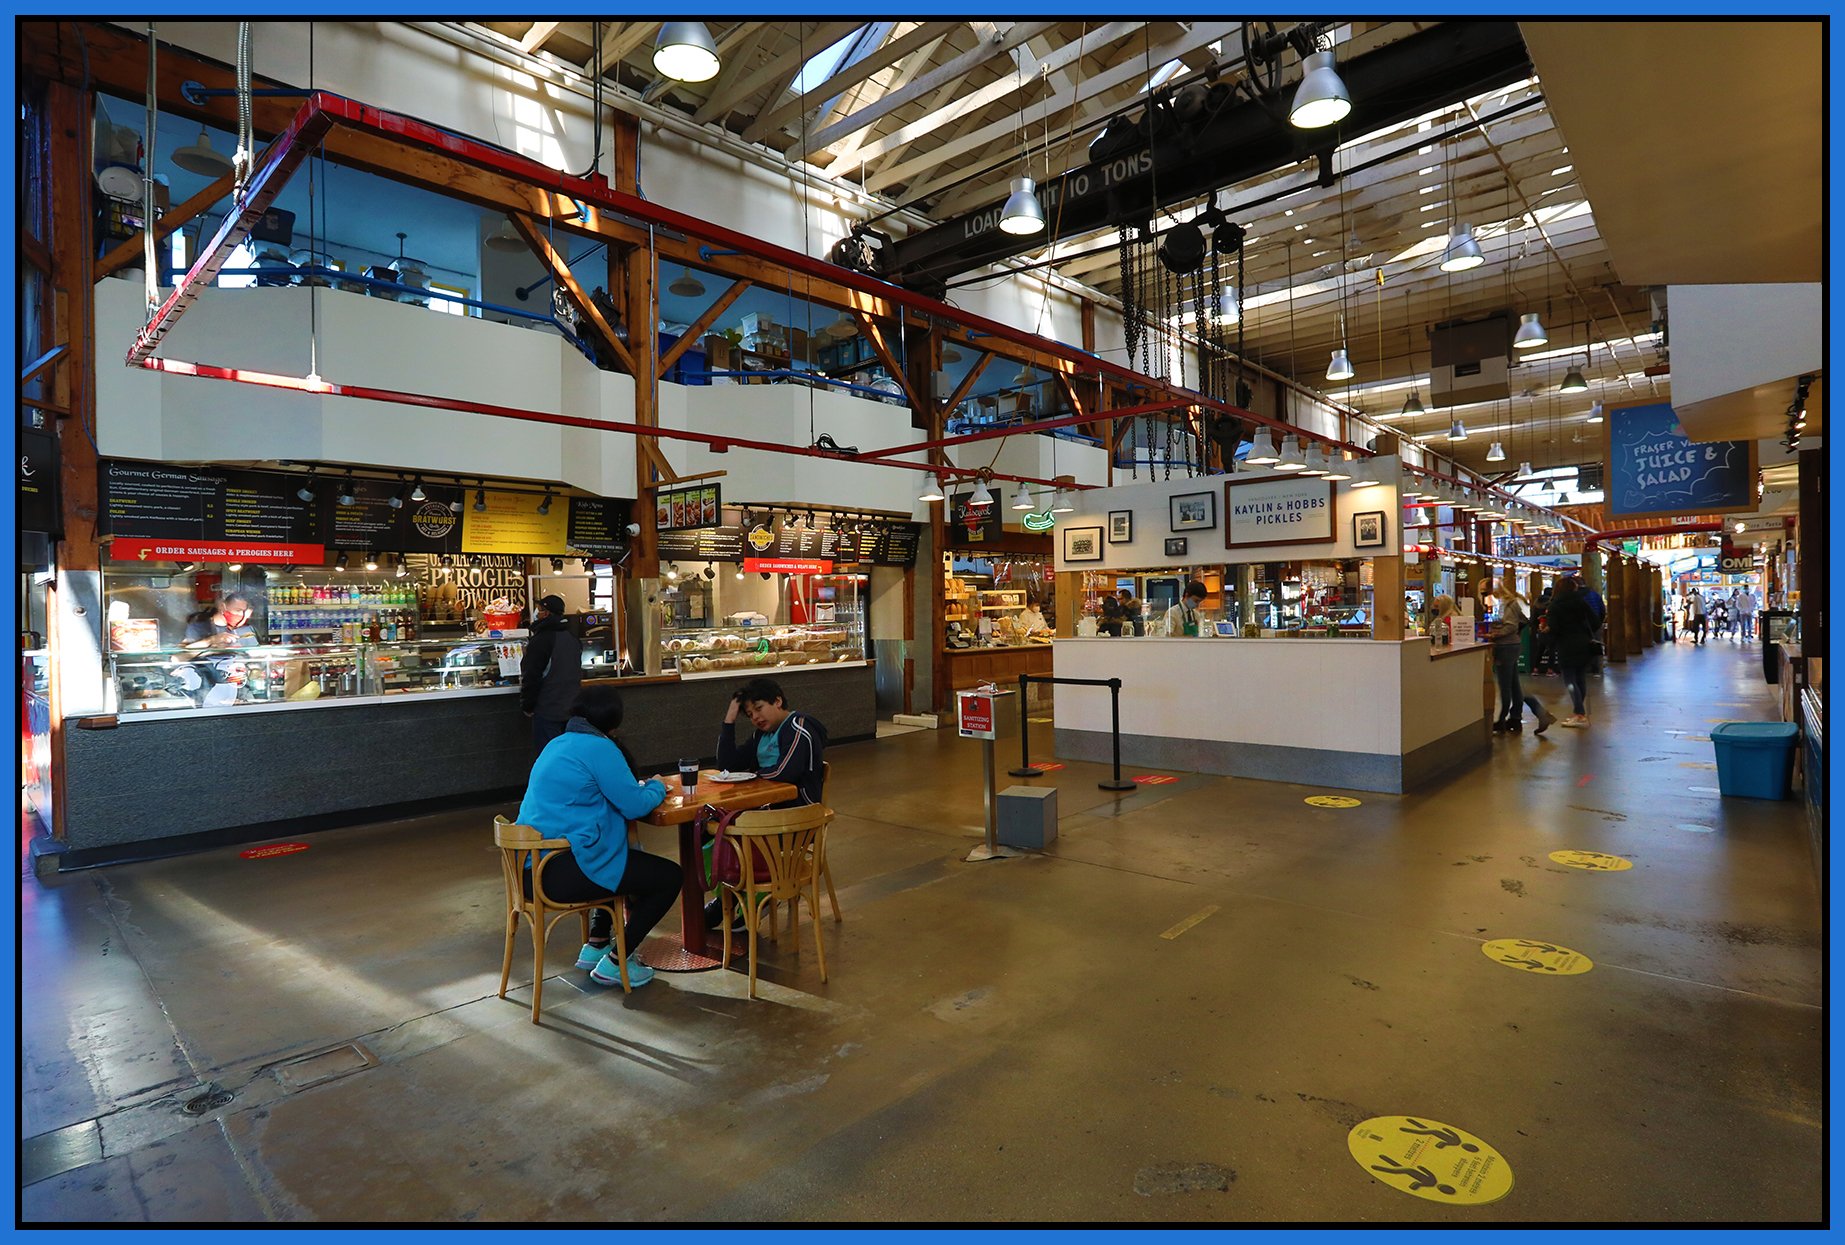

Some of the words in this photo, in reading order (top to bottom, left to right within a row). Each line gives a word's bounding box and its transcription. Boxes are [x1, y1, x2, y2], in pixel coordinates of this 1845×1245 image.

[1101, 149, 1153, 187] TONS
[1634, 440, 1674, 457] FRASER
[1636, 450, 1696, 472] JUICE
[1704, 446, 1718, 460] &
[109, 468, 150, 478] Gourmet
[152, 471, 187, 480] German
[188, 473, 228, 484] Sausages
[1636, 466, 1692, 490] SALAD
[1235, 503, 1273, 515] KAYLIN
[1287, 498, 1325, 510] HOBBS
[412, 514, 456, 525] BRATWURST
[1256, 512, 1302, 525] PICKLES
[155, 546, 186, 555] ORDER
[187, 548, 227, 556] SAUSAGES
[236, 549, 272, 557] PEROGIES
[430, 568, 525, 588] PEROGIES
